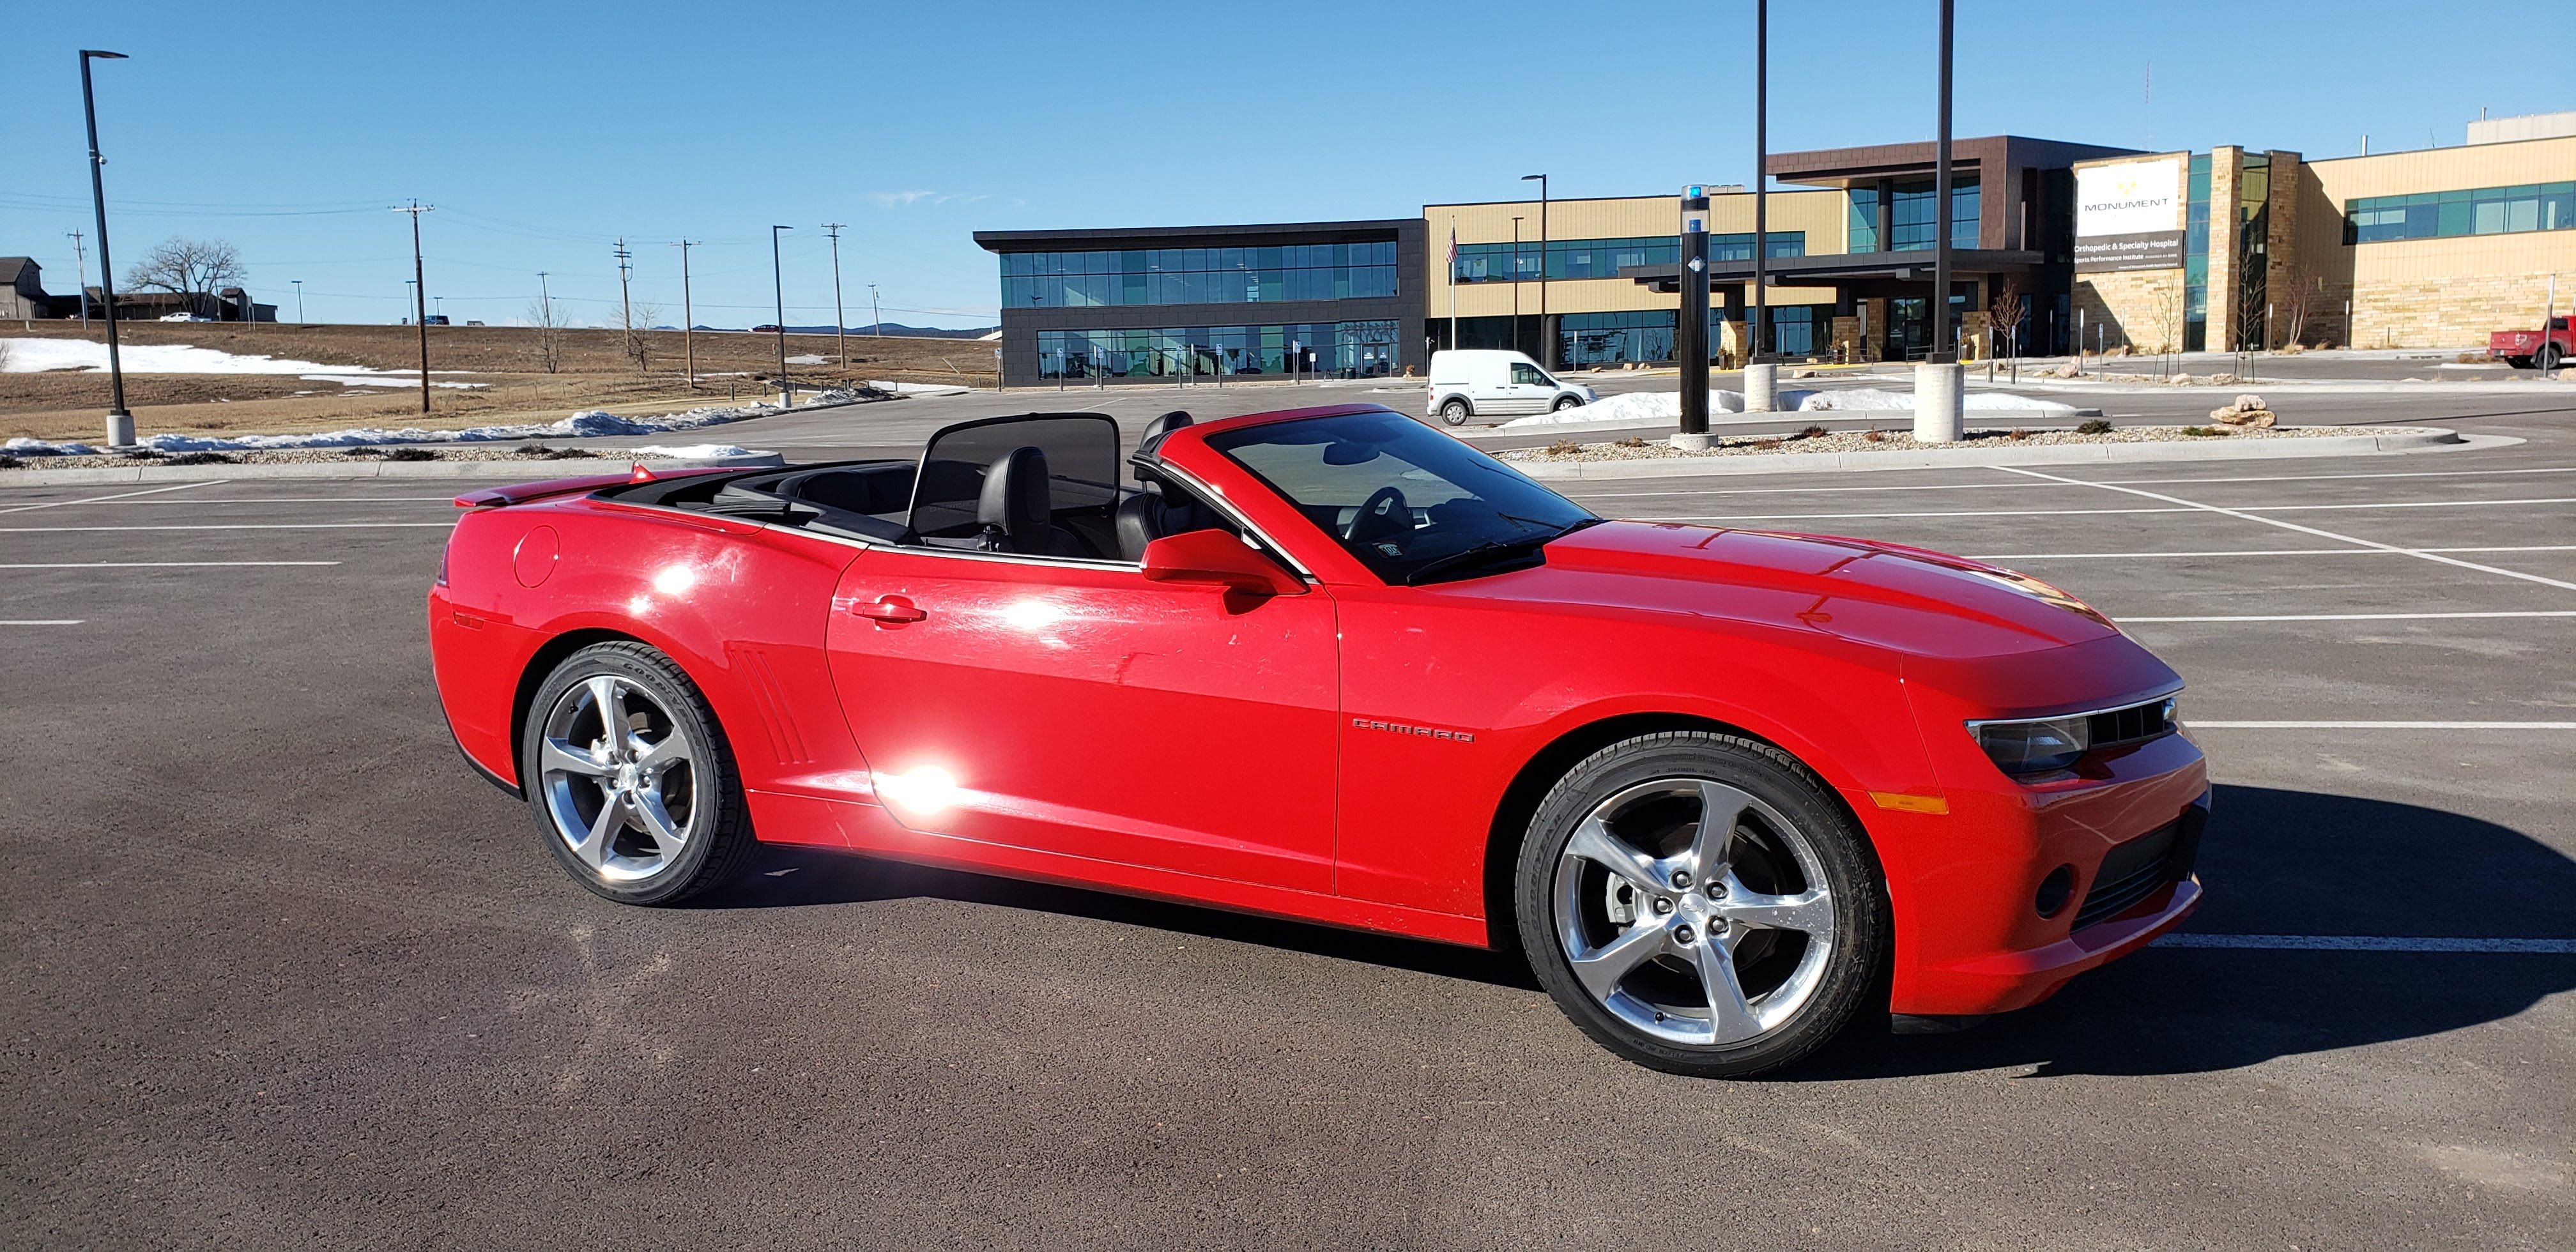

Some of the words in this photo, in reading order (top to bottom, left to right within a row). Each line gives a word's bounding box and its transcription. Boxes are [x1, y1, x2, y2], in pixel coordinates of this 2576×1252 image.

[2085, 198, 2169, 211] MONUMENT
[2074, 243, 2111, 253] Orthopedic
[2119, 240, 2149, 251] Specialty
[2150, 238, 2179, 248] Hospital
[1353, 717, 1475, 743] CAMARO
